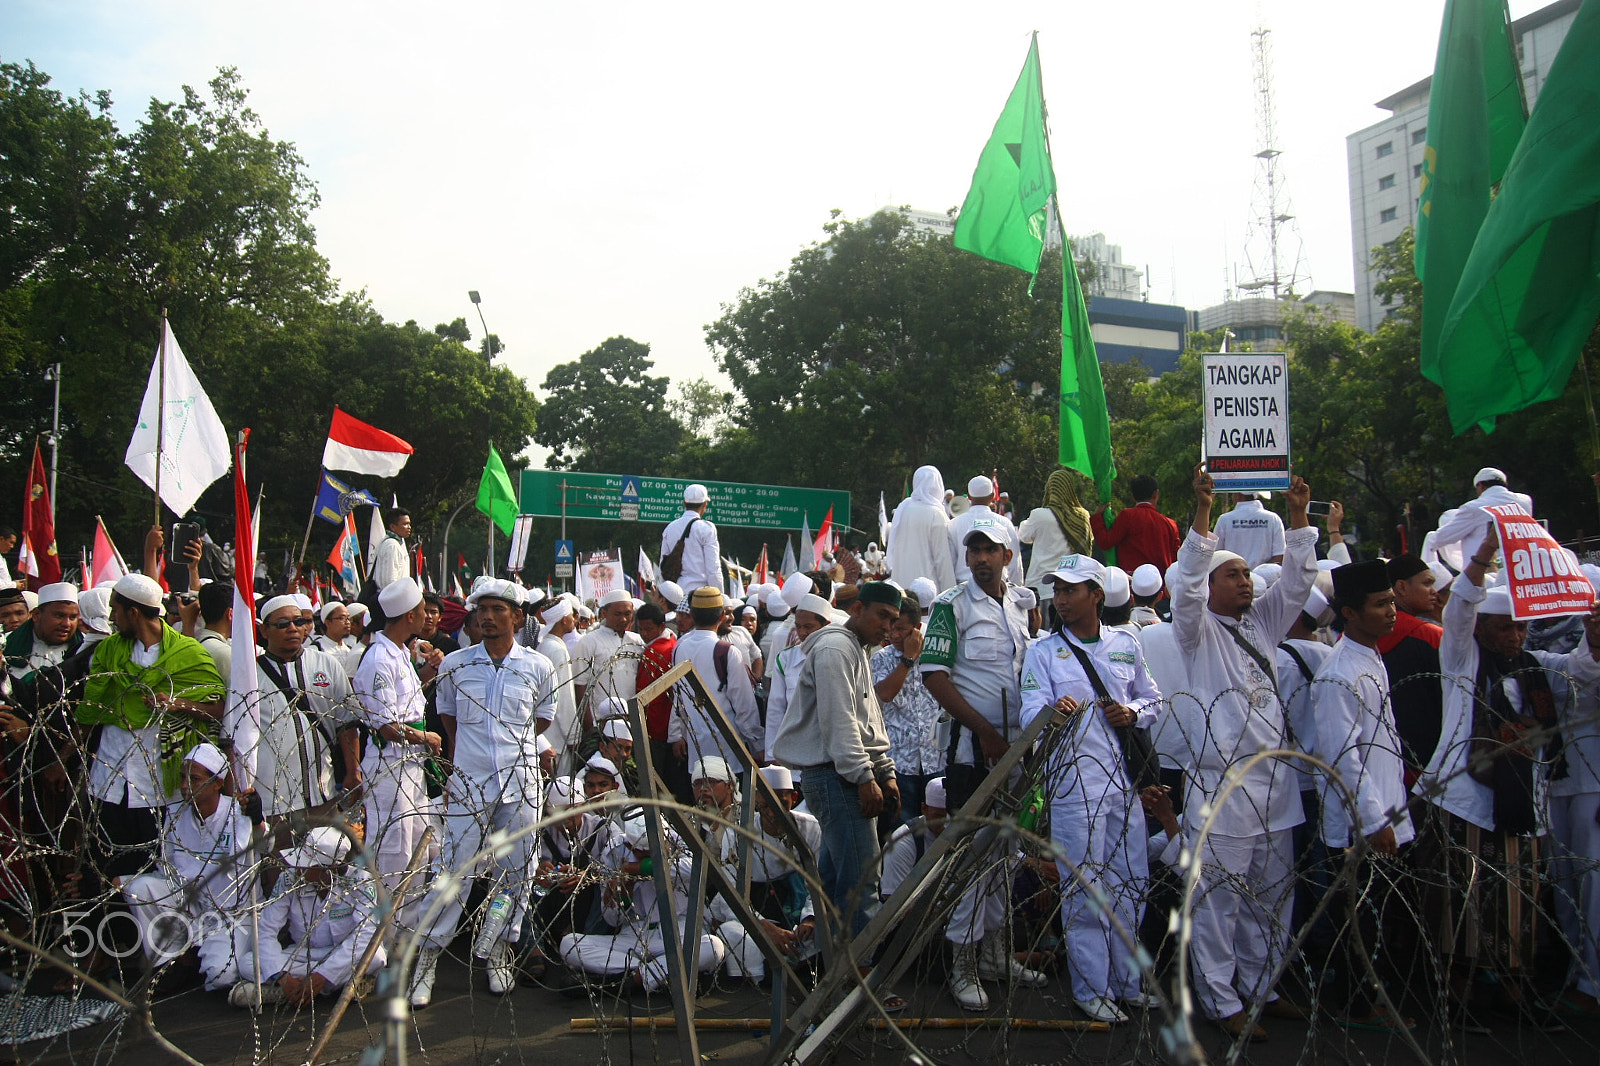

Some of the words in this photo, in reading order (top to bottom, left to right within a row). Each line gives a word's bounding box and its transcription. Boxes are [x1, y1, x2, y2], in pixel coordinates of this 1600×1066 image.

[1207, 365, 1282, 385] TANGKAP
[1214, 397, 1279, 417] PENISTA
[1218, 428, 1277, 448] AGAMA
[1216, 459, 1260, 470] PENJARAKAN
[1261, 459, 1280, 469] AHOK
[641, 481, 667, 489] 07.00
[756, 489, 779, 497] 20.00
[585, 493, 622, 501] Kawasa
[638, 496, 684, 504] embatasa
[741, 502, 765, 510] Ganjil
[773, 504, 799, 512] Genap
[644, 503, 673, 511] Nomor
[716, 508, 748, 516] Tanggal
[753, 509, 776, 518] Ganjil
[717, 515, 750, 523] Tanggal
[755, 517, 781, 525] Genap
[1515, 585, 1525, 599] SI
[1525, 582, 1558, 598] PENISTA
[923, 636, 951, 654] PAM
